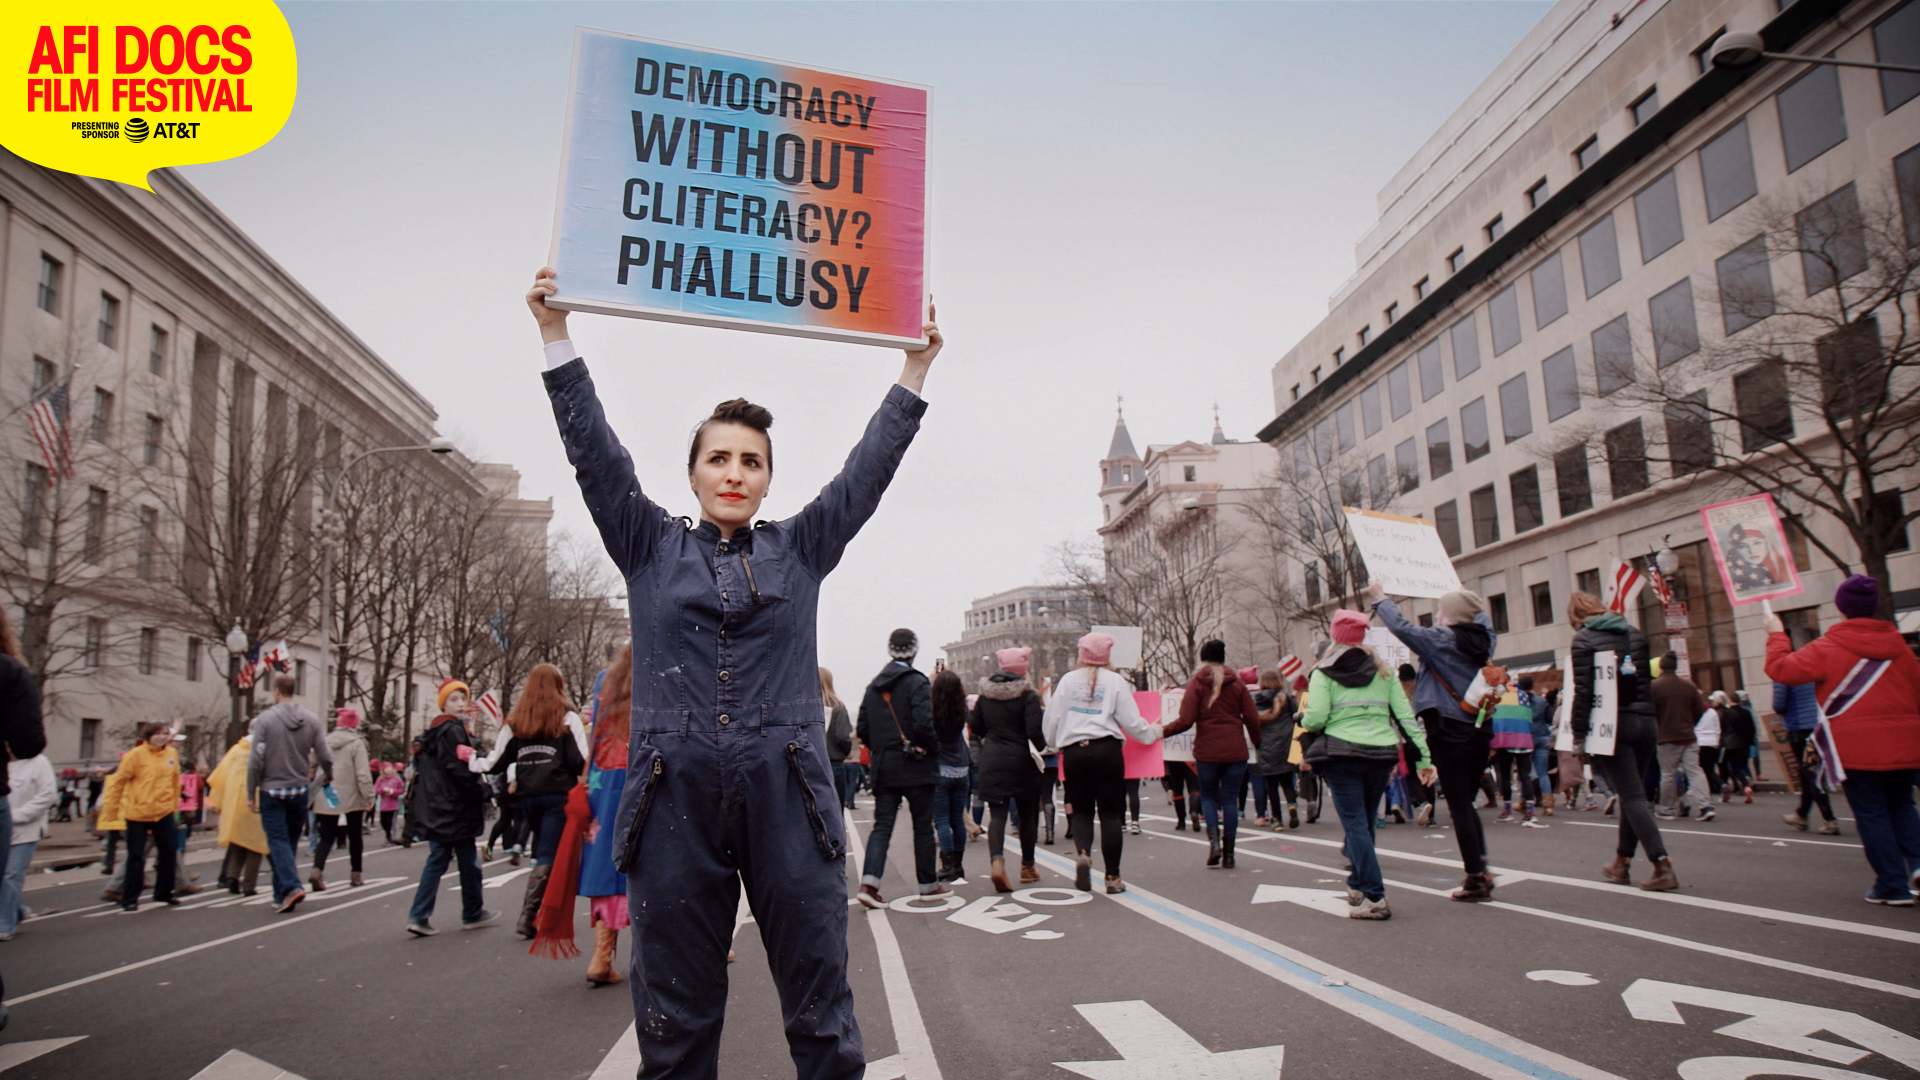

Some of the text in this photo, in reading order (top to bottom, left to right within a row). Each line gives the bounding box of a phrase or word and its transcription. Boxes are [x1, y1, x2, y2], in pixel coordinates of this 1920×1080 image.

[634, 57, 876, 130] DEMOCRACY
[630, 109, 875, 194] WITHOUT
[622, 178, 872, 249] CLITERACY?
[616, 235, 870, 313] PHALLUSY
[1386, 645, 1406, 658] THE
